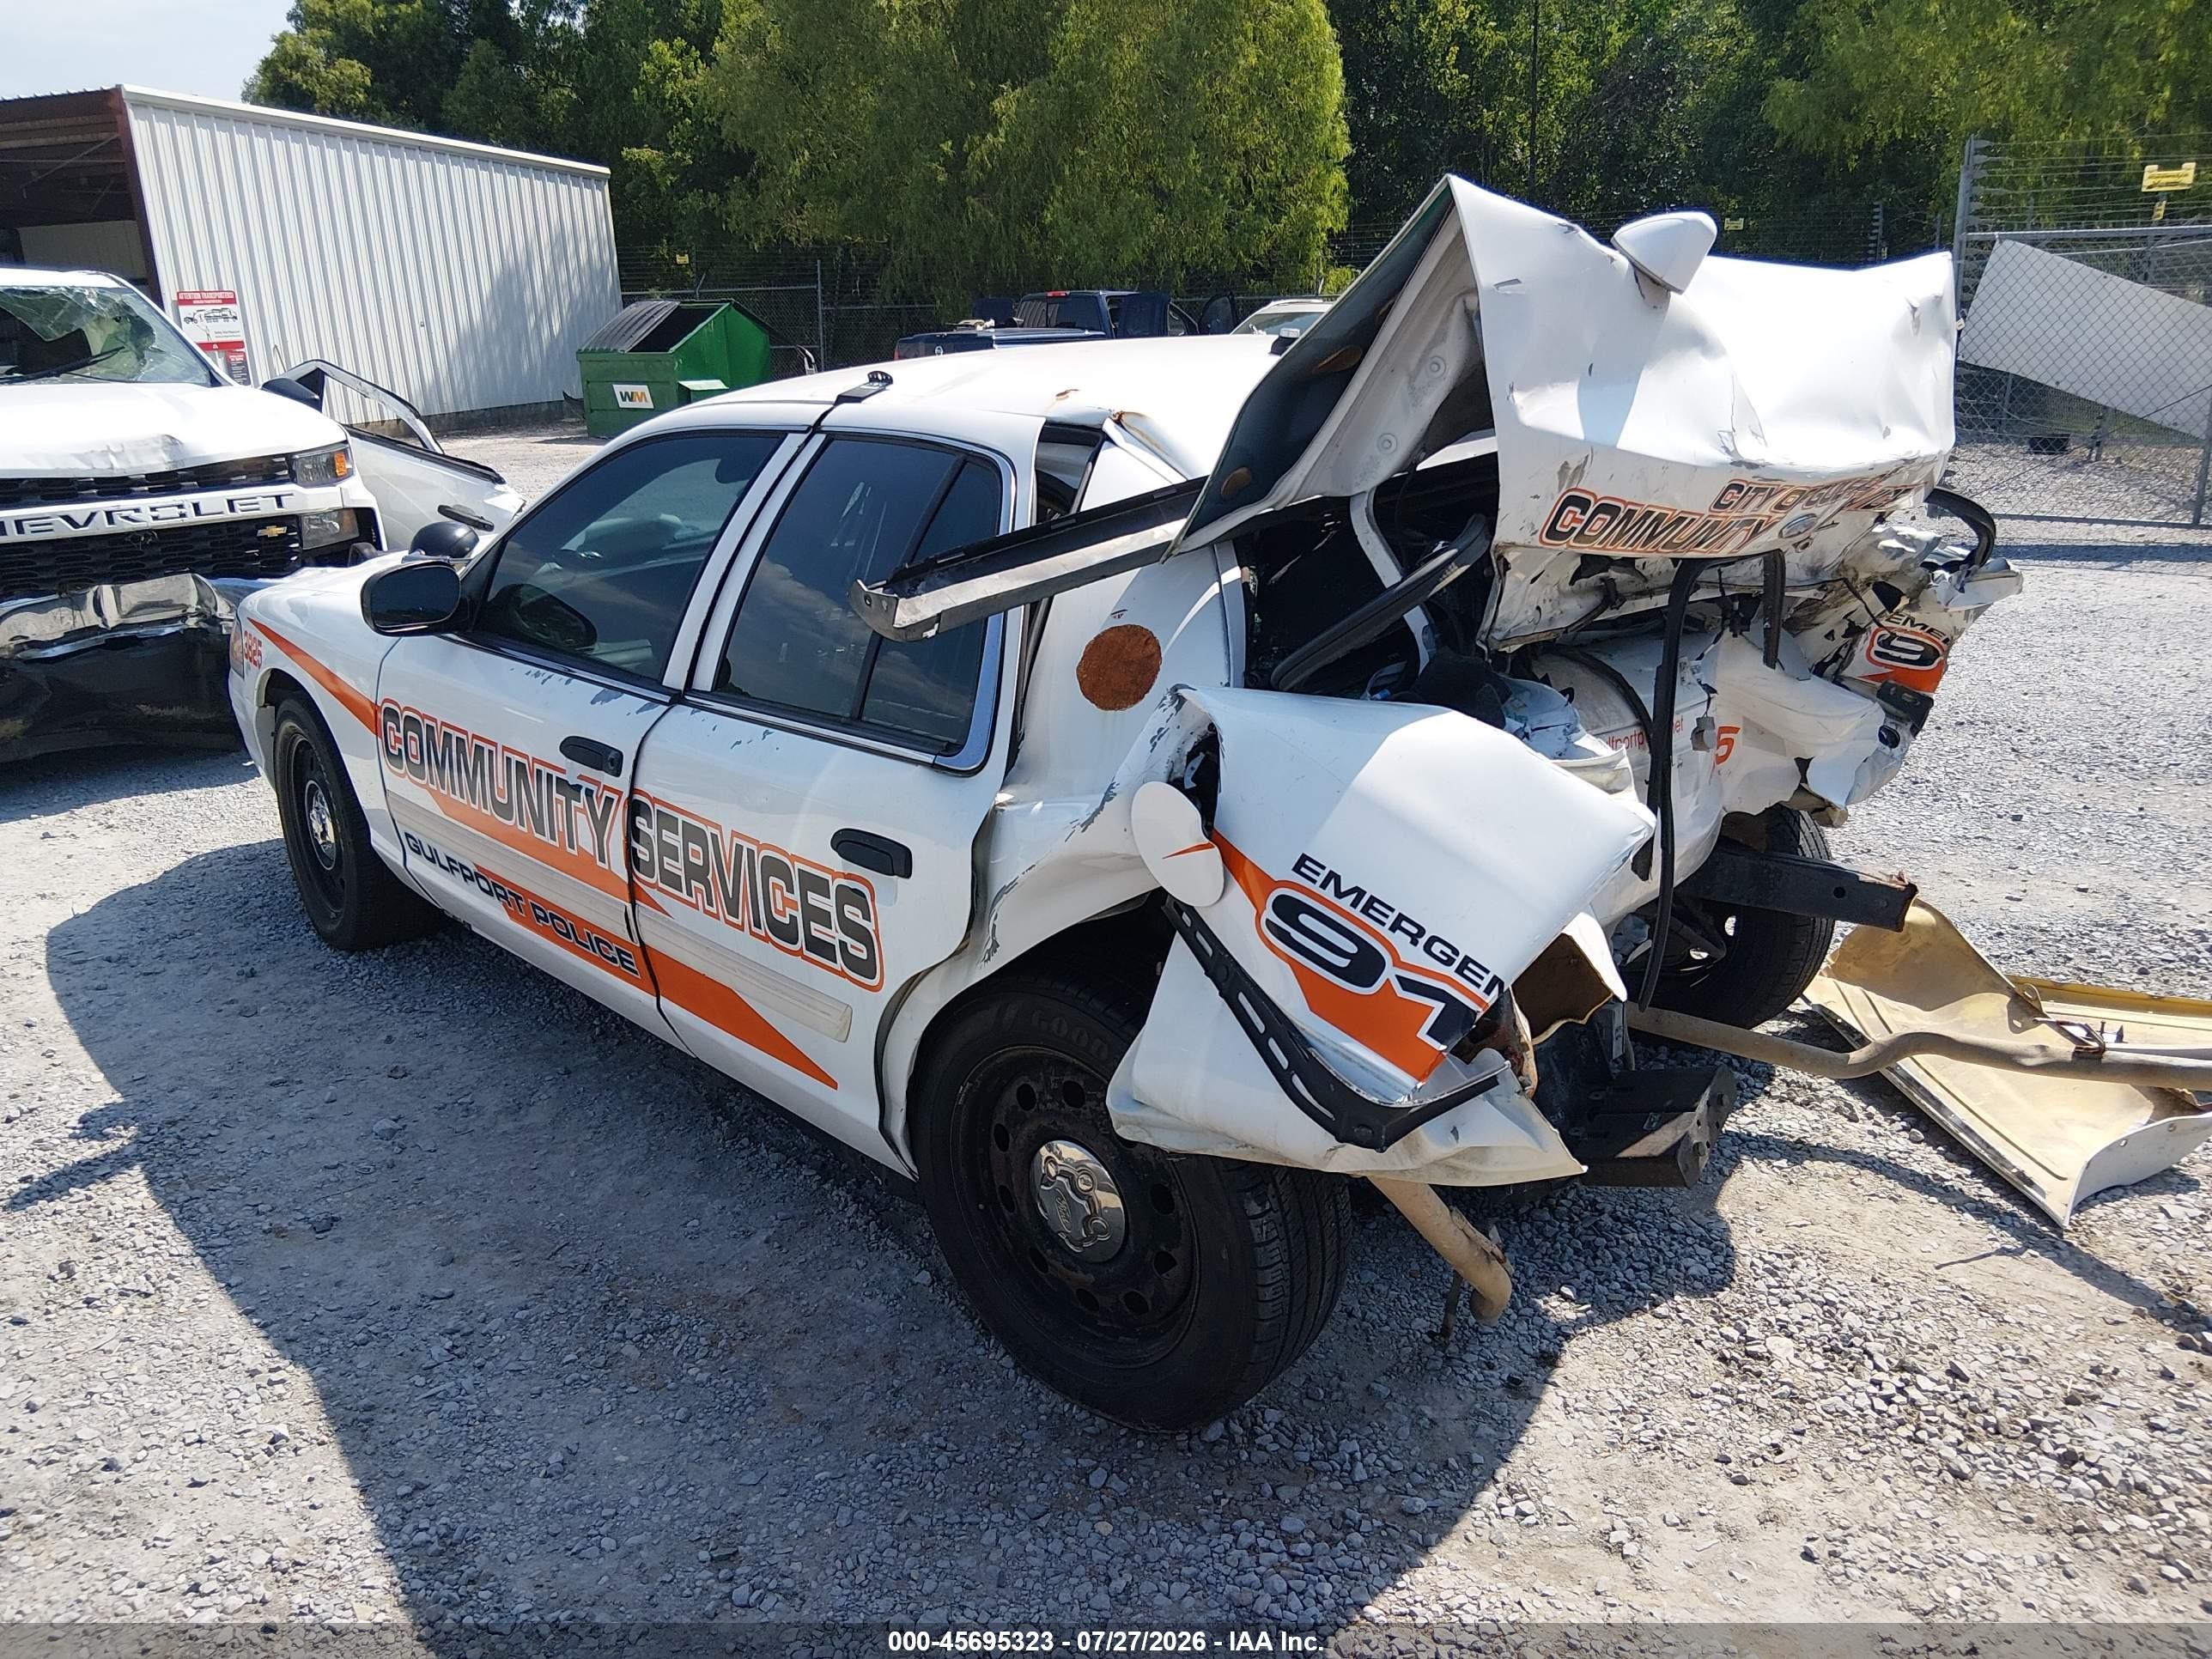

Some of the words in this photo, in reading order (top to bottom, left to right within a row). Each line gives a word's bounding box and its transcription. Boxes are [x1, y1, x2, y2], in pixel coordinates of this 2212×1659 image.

[619, 391, 647, 403] WM
[0, 492, 295, 536] EVROLET
[1540, 488, 1780, 554] COMMUNITY
[1710, 478, 1778, 514] CITY
[380, 699, 622, 868] COMMUNITY
[627, 793, 883, 988] SERVICES
[404, 831, 526, 917] GULFPORT
[529, 901, 641, 979] POLICE
